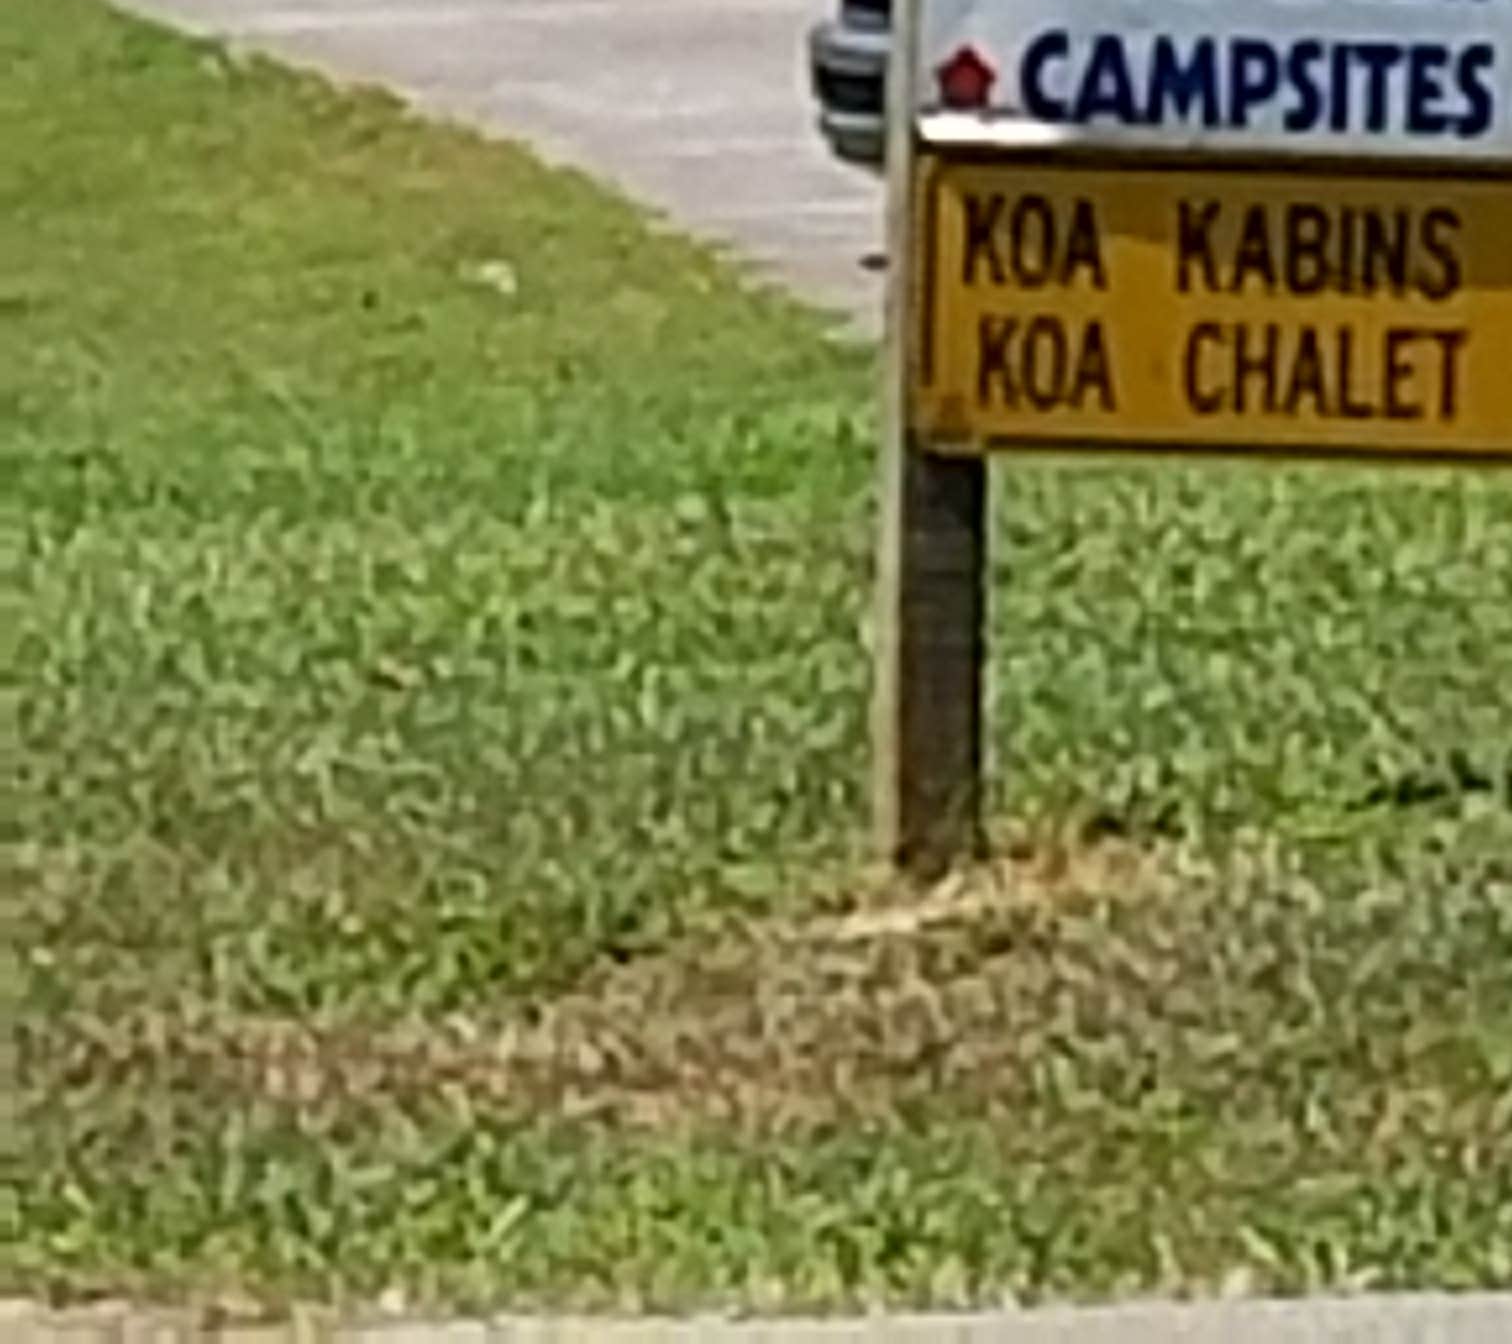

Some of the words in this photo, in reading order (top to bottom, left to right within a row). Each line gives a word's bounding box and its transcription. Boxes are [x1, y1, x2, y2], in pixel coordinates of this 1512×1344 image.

[1019, 30, 1494, 140] CAMPSITES
[962, 194, 1108, 290] KOA
[1176, 199, 1462, 300] KABINS
[977, 315, 1117, 412] KOA
[1182, 323, 1467, 421] CHALET
